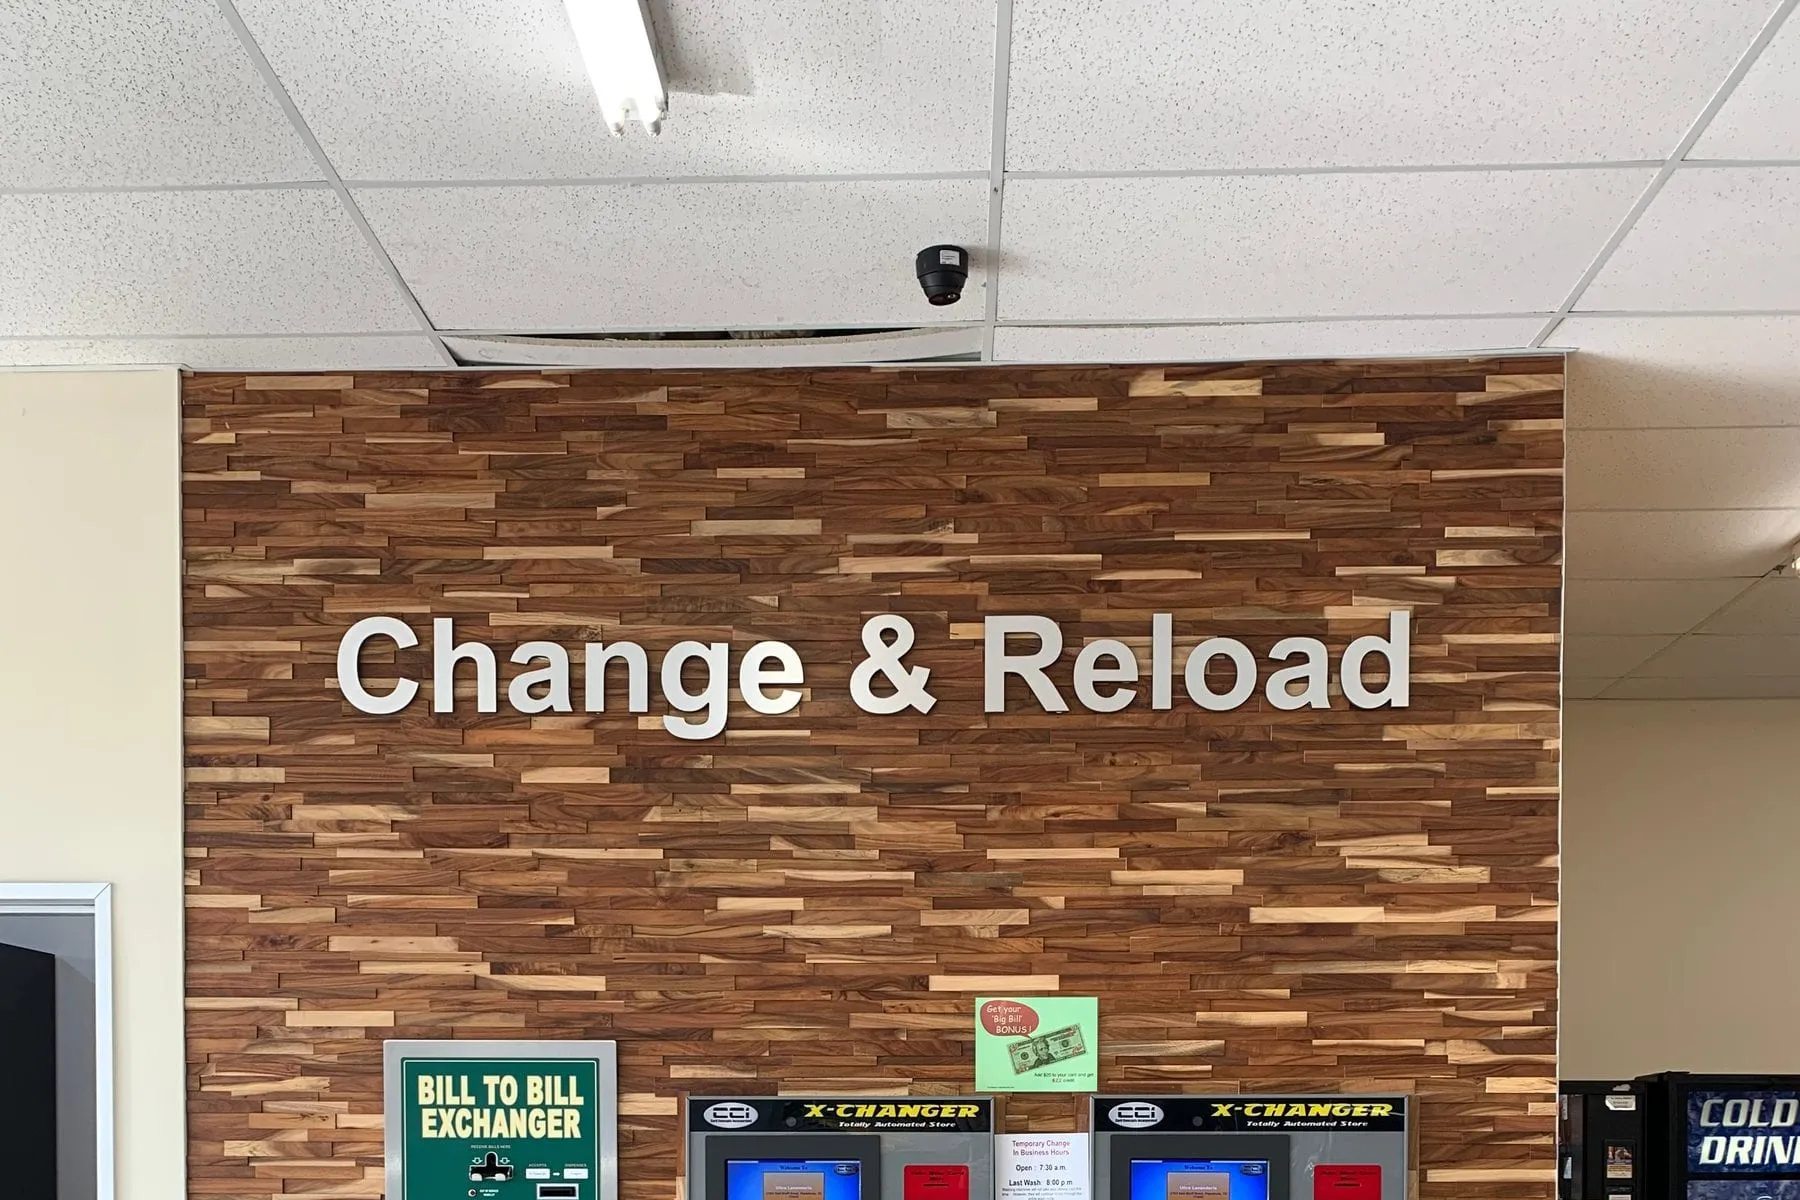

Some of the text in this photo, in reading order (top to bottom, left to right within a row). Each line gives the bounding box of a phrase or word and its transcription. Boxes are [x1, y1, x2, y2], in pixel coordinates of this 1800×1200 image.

[336, 610, 1411, 741] Change & Reload
[986, 1005, 1022, 1016] Get your
[418, 1075, 584, 1106] BILL TO BILL
[804, 1103, 980, 1118] X-CHANGER
[1211, 1102, 1393, 1117] X-CHANGER
[1699, 1098, 1799, 1128] COLD
[421, 1108, 582, 1139] EXCHANGER
[838, 1121, 872, 1129] Totally
[1246, 1120, 1281, 1129] Totally
[1012, 1140, 1071, 1149] Temporary Change
[1015, 1164, 1033, 1173] Open
[1008, 1179, 1023, 1187] Last
[1023, 1179, 1041, 1187] Wash
